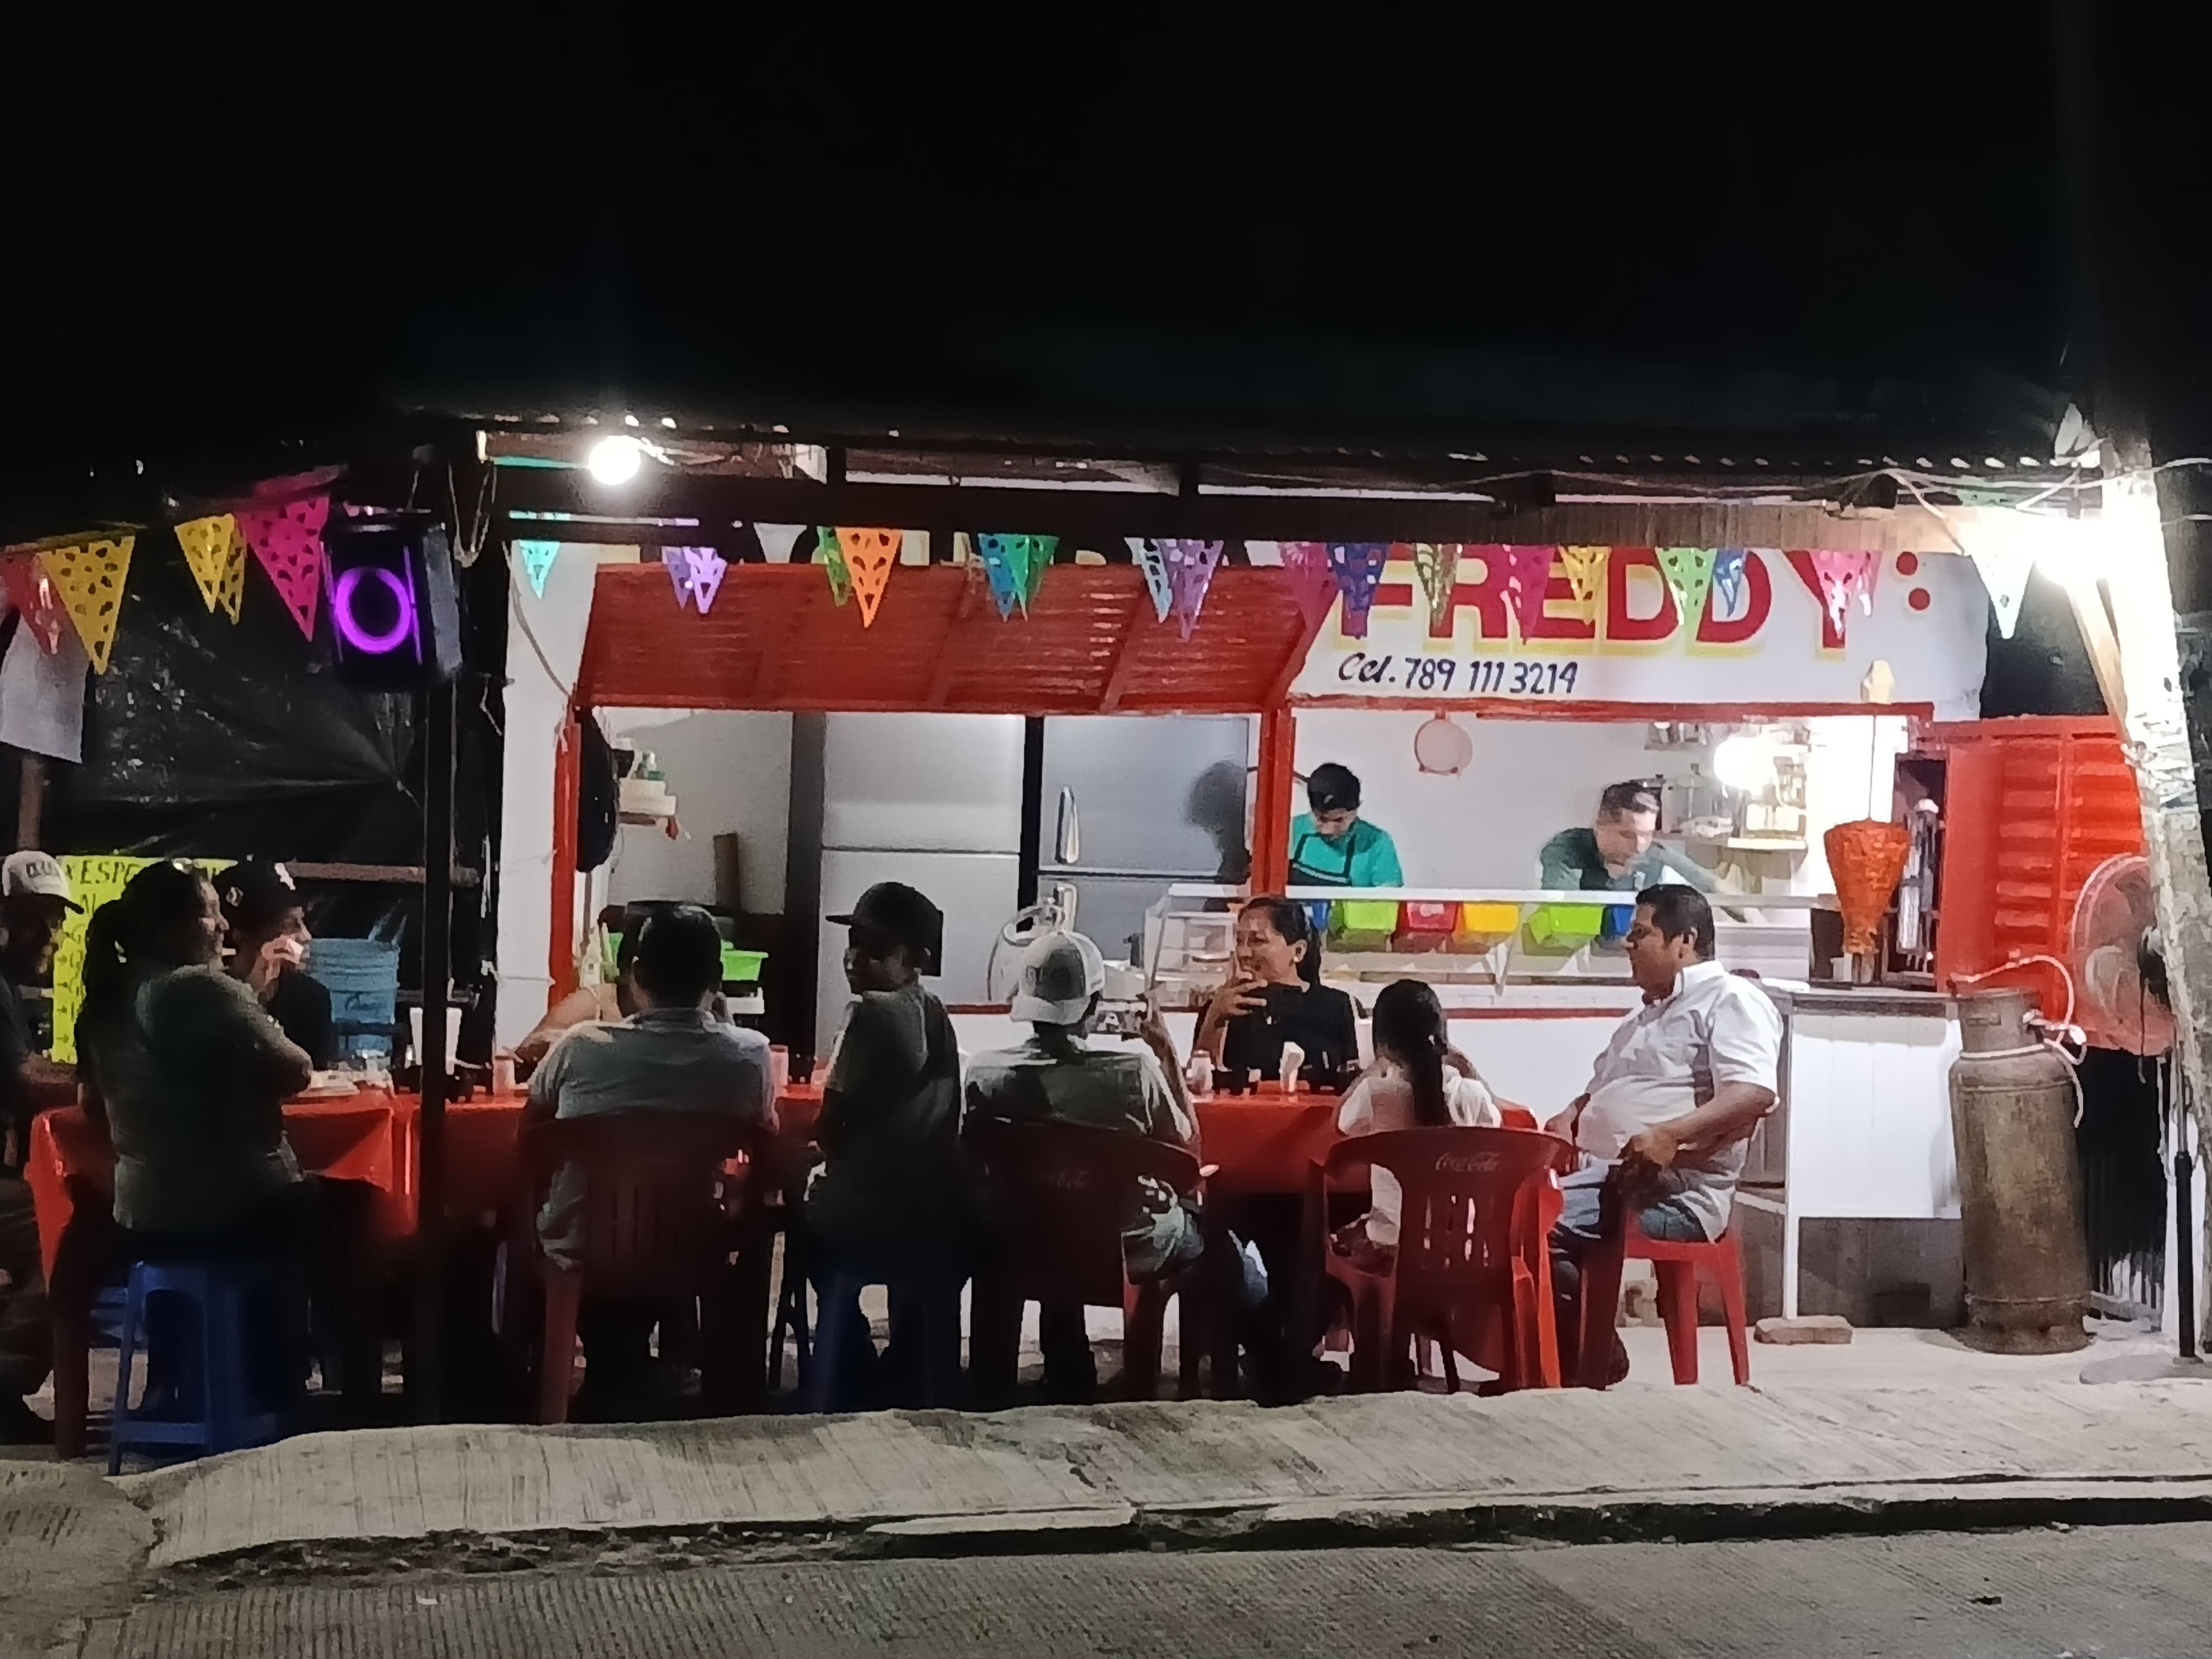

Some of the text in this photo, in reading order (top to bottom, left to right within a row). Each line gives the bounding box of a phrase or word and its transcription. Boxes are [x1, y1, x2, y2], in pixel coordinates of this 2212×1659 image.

[1340, 542, 1884, 648] FREDDY
[1338, 652, 1578, 695] Cel. 789 111 3214
